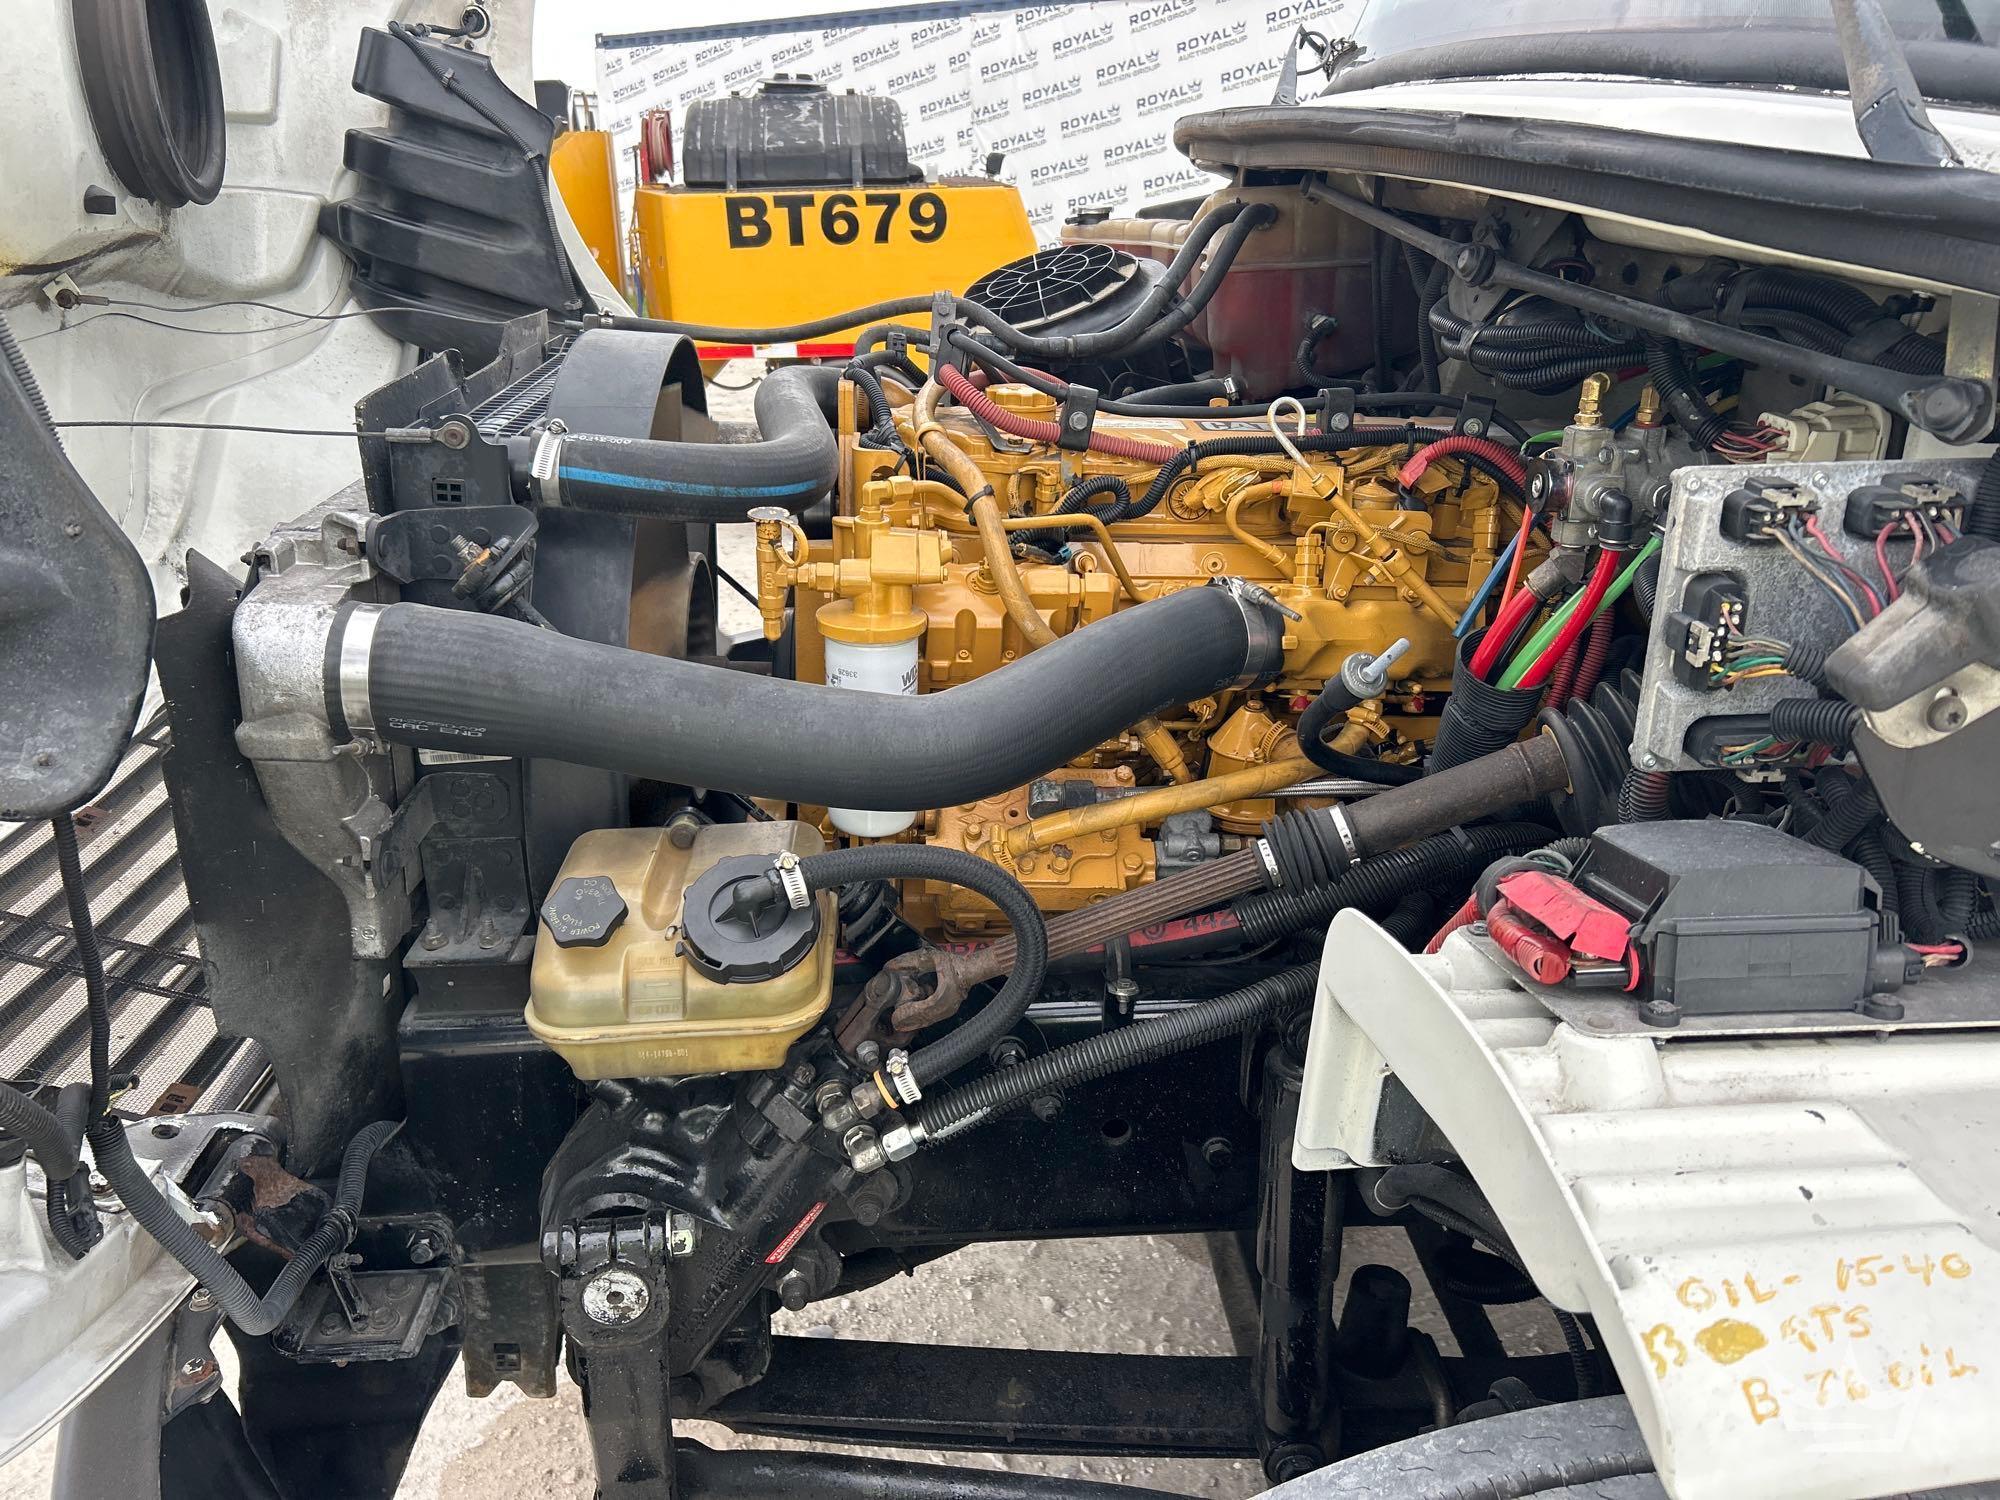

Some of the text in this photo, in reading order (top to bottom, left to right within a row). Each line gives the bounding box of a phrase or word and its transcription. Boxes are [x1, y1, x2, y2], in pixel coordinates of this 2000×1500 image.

[1129, 0, 1180, 26] ROYAL
[1131, 7, 1197, 34] AUCTION GROUP
[1265, 0, 1326, 24] ROYAL
[1267, 3, 1345, 34] AUCTION GROUP
[911, 21, 950, 42] ROYAL
[1052, 29, 1100, 53] ROYAL
[1177, 28, 1231, 53] ROYAL
[695, 44, 726, 62] ROYAL
[772, 43, 803, 63] ROYAL
[852, 45, 889, 65] ROYAL
[1178, 35, 1248, 62] AUCTION GROUP
[653, 65, 682, 81] ROYAL
[724, 65, 753, 83] ROYAL
[980, 54, 1026, 77] ROYAL
[1096, 56, 1145, 80] ROYAL
[1221, 59, 1277, 85] ROYAL
[888, 69, 926, 90] ROYAL
[1222, 76, 1261, 93] AUCTION
[613, 83, 639, 98] ROYAL
[681, 84, 708, 101] ROYAL
[1022, 80, 1068, 102] ROYAL
[1136, 86, 1188, 109] ROYAL
[920, 94, 960, 115] ROYAL
[1060, 110, 1108, 132] ROYAL
[907, 141, 934, 156] OYAL
[992, 132, 1033, 151] ROYAL
[1104, 139, 1152, 160] ROYAL
[1031, 159, 1076, 180] ROYAL
[1143, 170, 1194, 190] ROYAL
[1068, 190, 1114, 209] ROYAL
[725, 192, 947, 249] BT679
[562, 913, 583, 926] FLUID
[570, 923, 600, 936] POWER
[1836, 1253, 1972, 1291] 15-40
